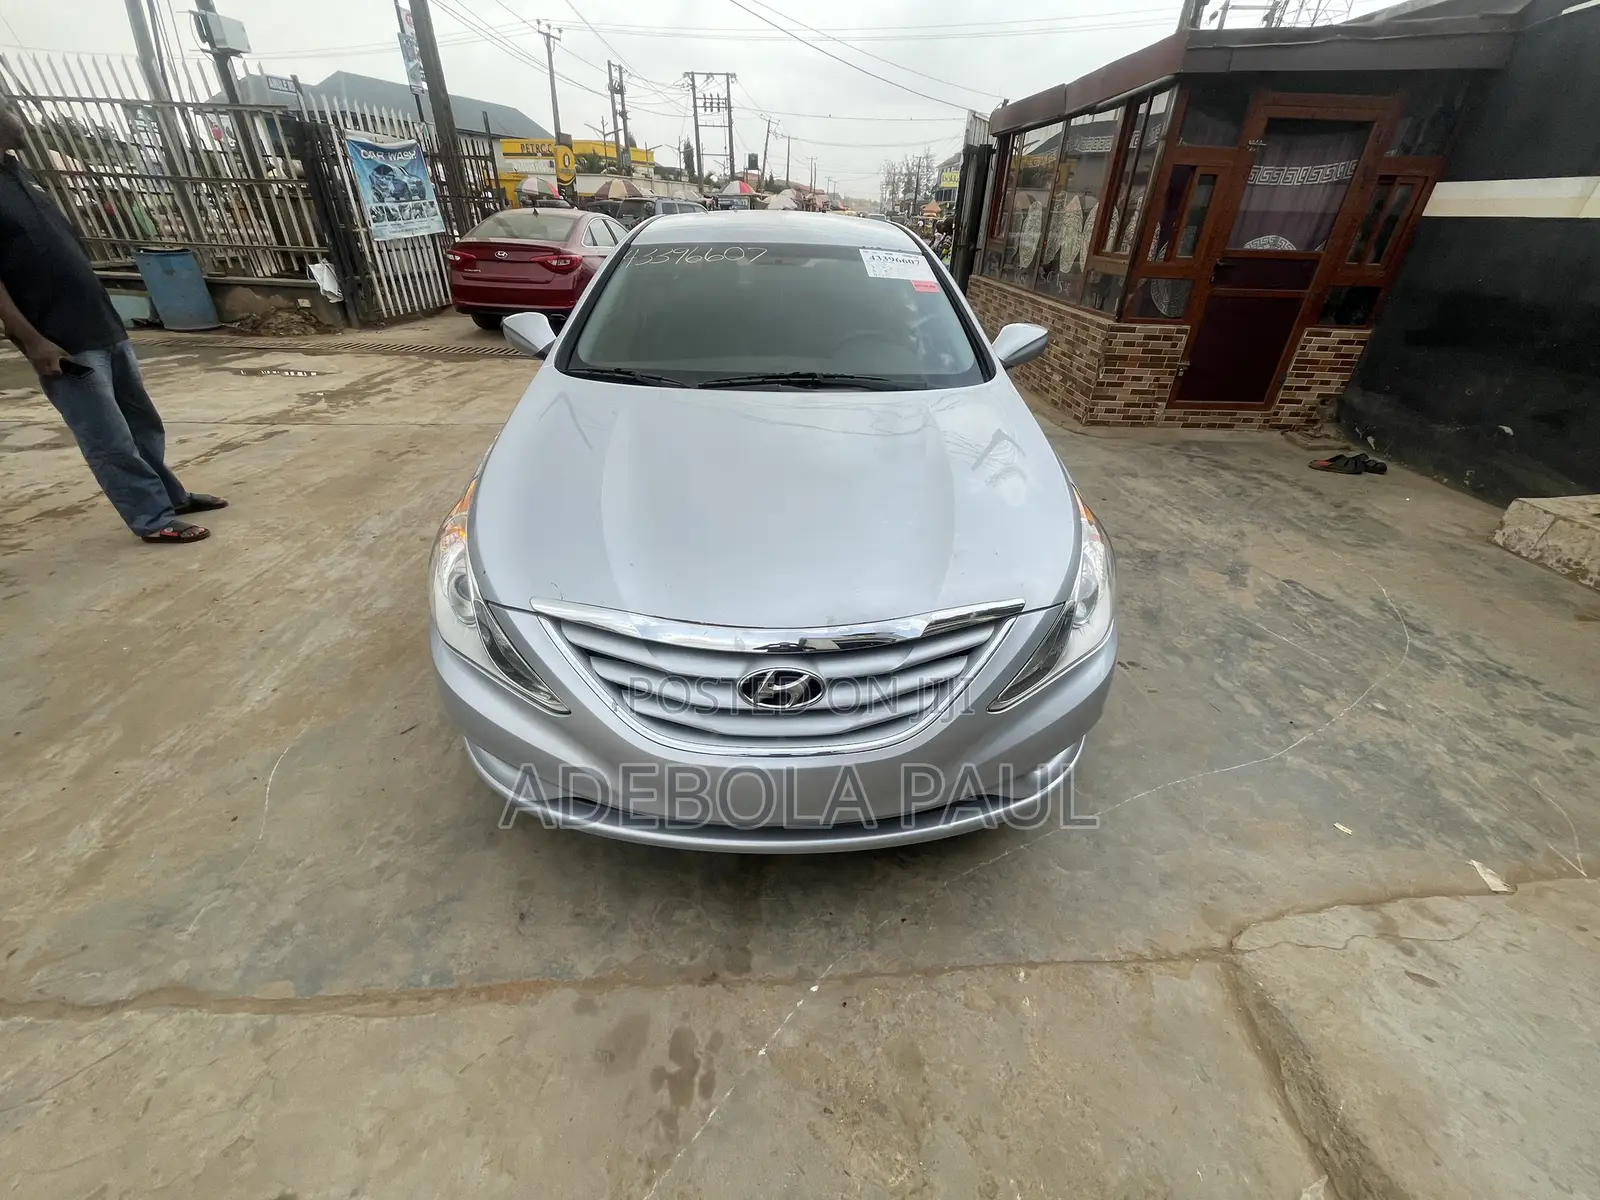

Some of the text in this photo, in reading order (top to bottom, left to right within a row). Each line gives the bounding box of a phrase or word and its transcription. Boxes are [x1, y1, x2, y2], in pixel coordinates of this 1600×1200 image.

[360, 149, 385, 160] CAR
[622, 245, 768, 268] 43396607
[869, 255, 920, 266] 43396607
